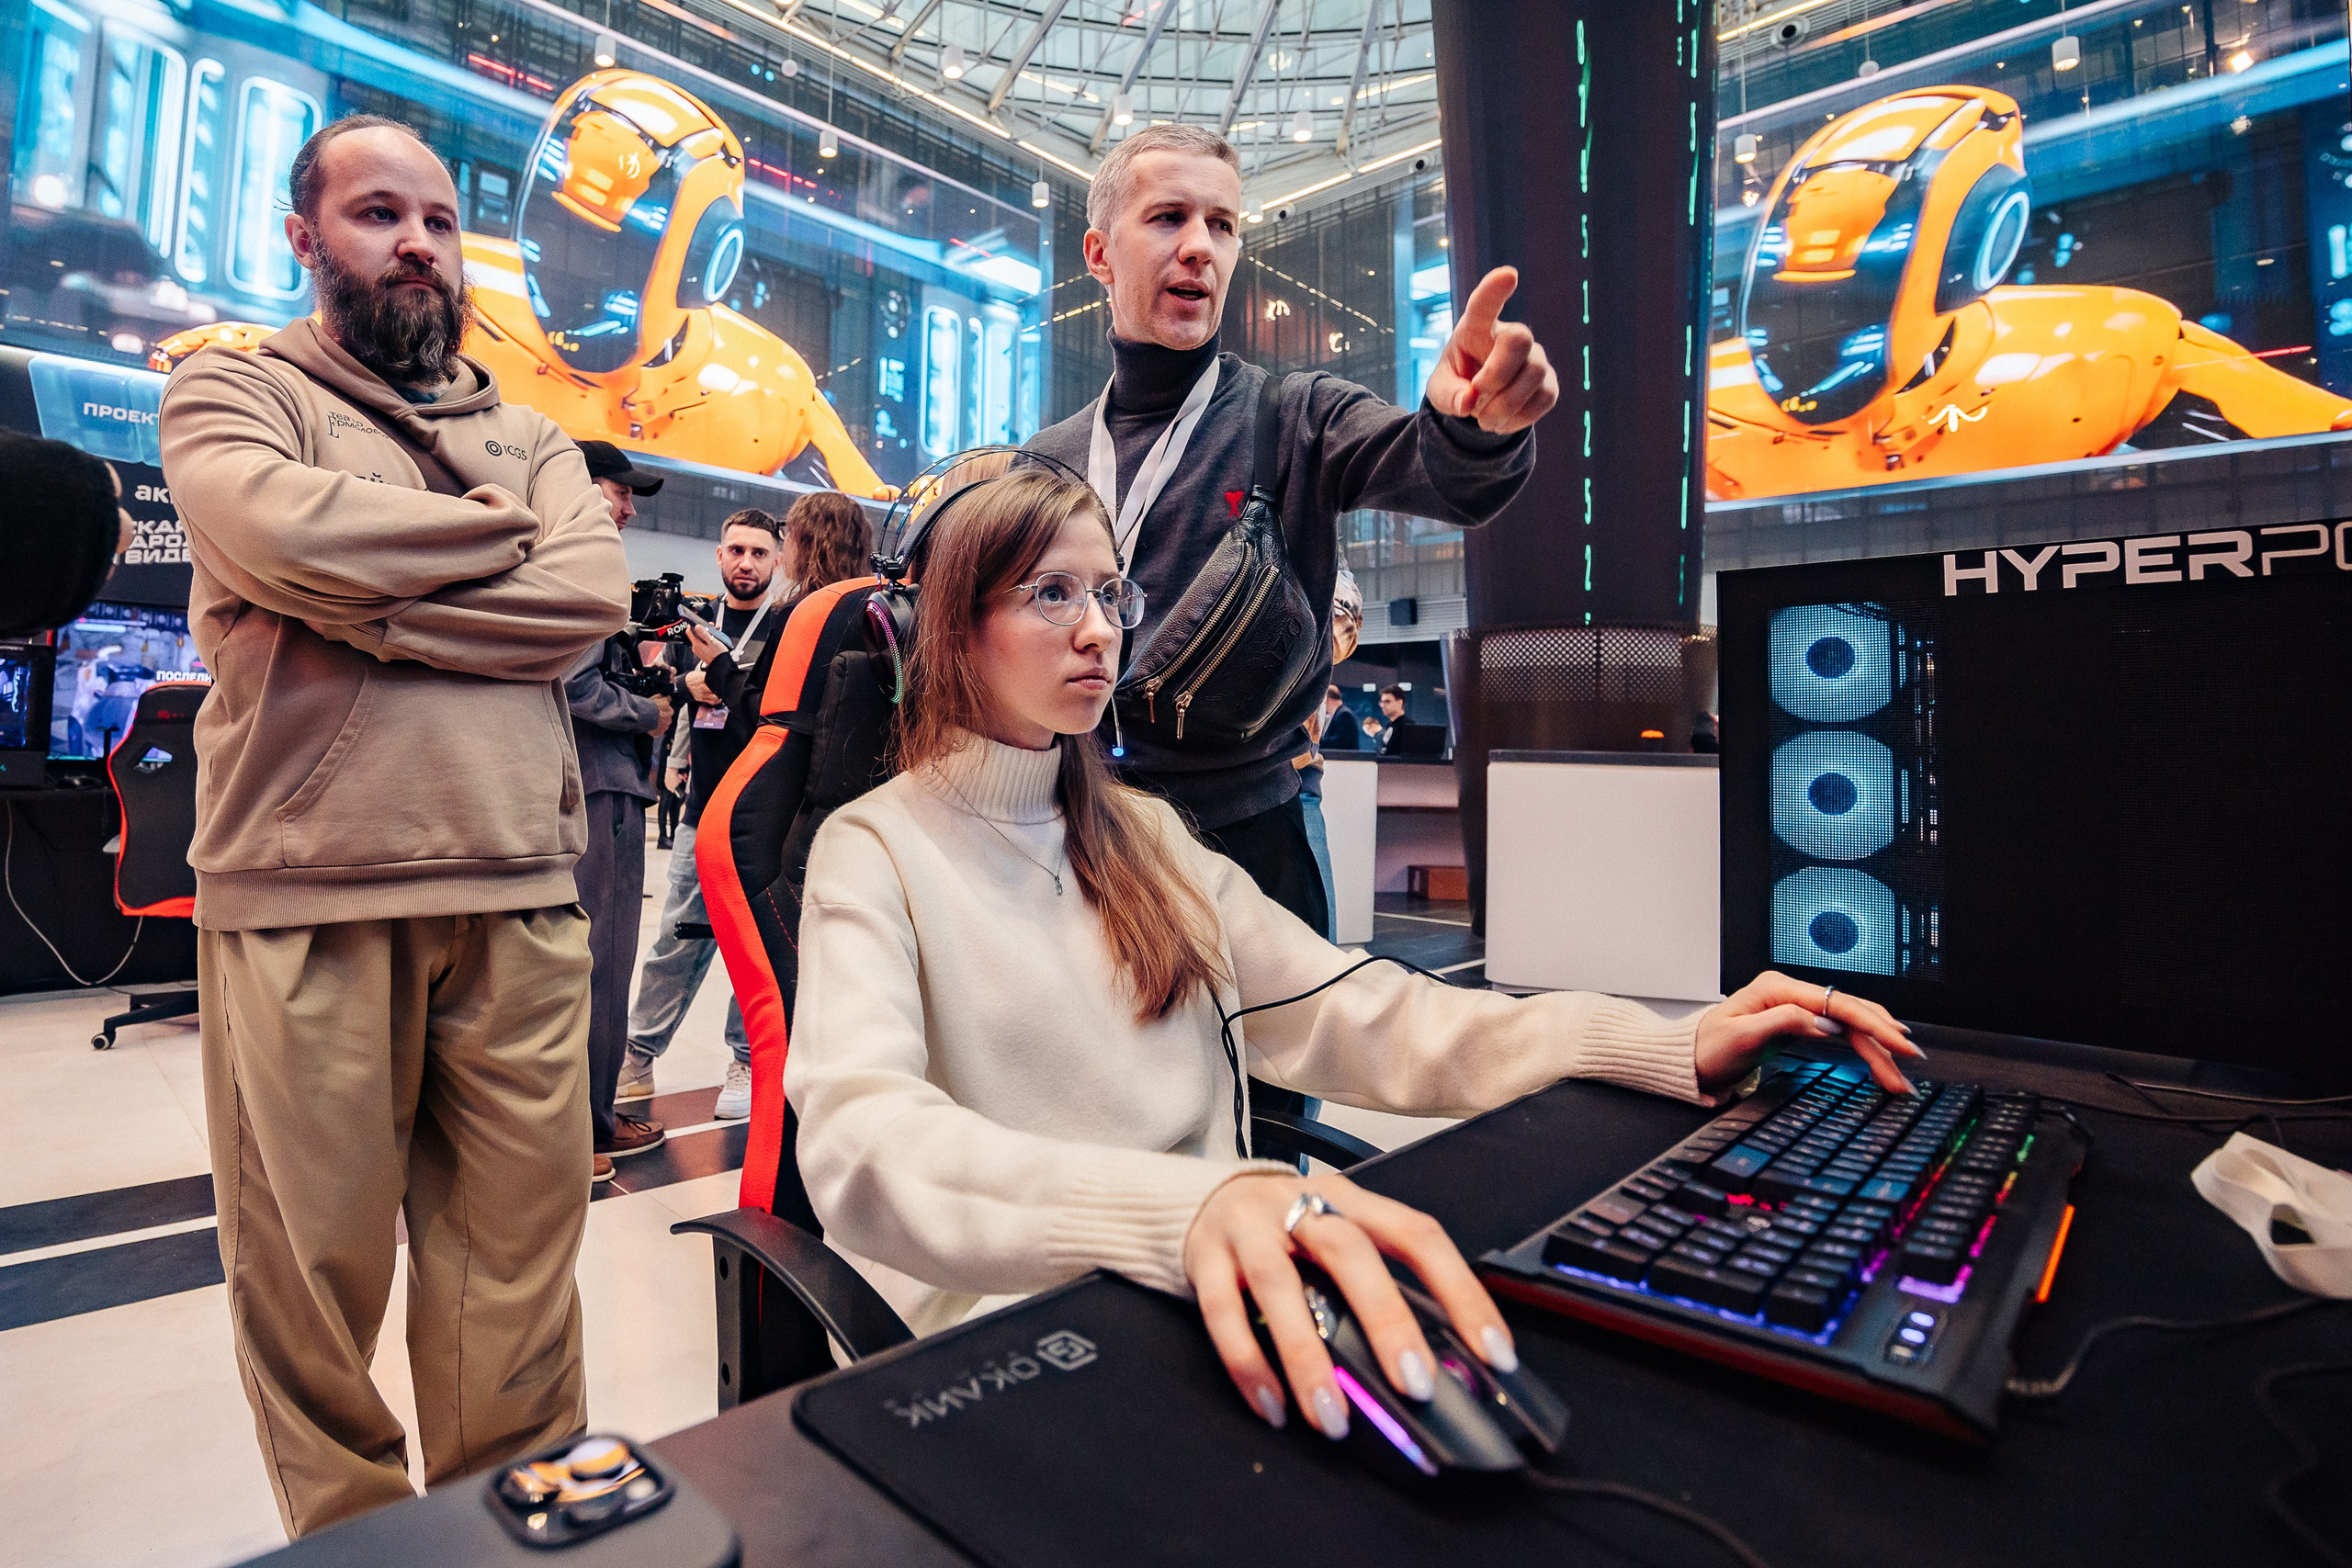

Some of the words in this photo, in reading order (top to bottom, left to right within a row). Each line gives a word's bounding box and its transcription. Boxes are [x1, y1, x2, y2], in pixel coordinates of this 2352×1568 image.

[83, 401, 160, 425] ПРОЕК
[503, 445, 528, 461] ICGS
[134, 484, 174, 504] ак
[128, 534, 189, 549] АРО
[1942, 520, 2352, 597] HYPERP
